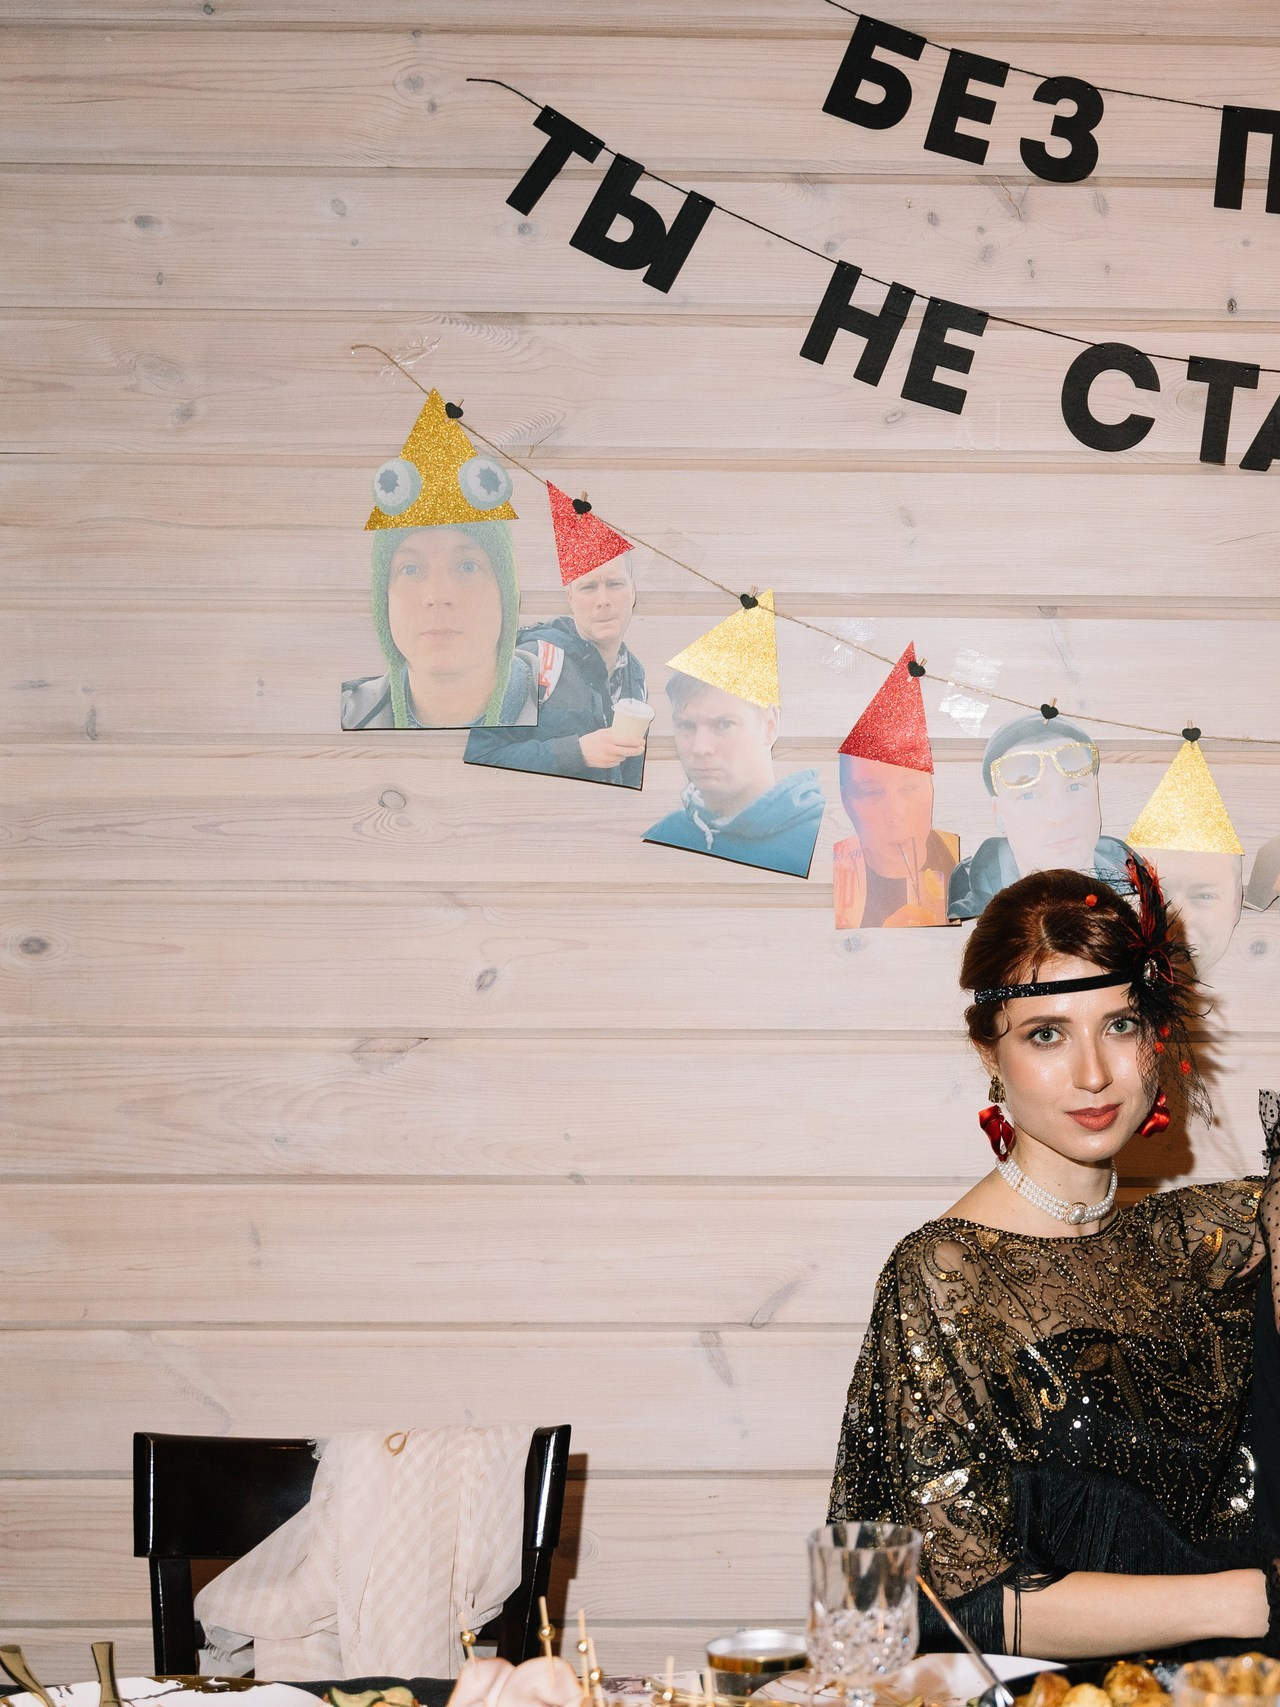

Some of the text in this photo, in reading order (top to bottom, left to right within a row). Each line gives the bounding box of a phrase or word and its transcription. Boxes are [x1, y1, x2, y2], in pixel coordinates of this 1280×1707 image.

[822, 14, 1104, 183] БЕЗ
[505, 105, 716, 294] ТЫ
[799, 260, 990, 415] НЕ
